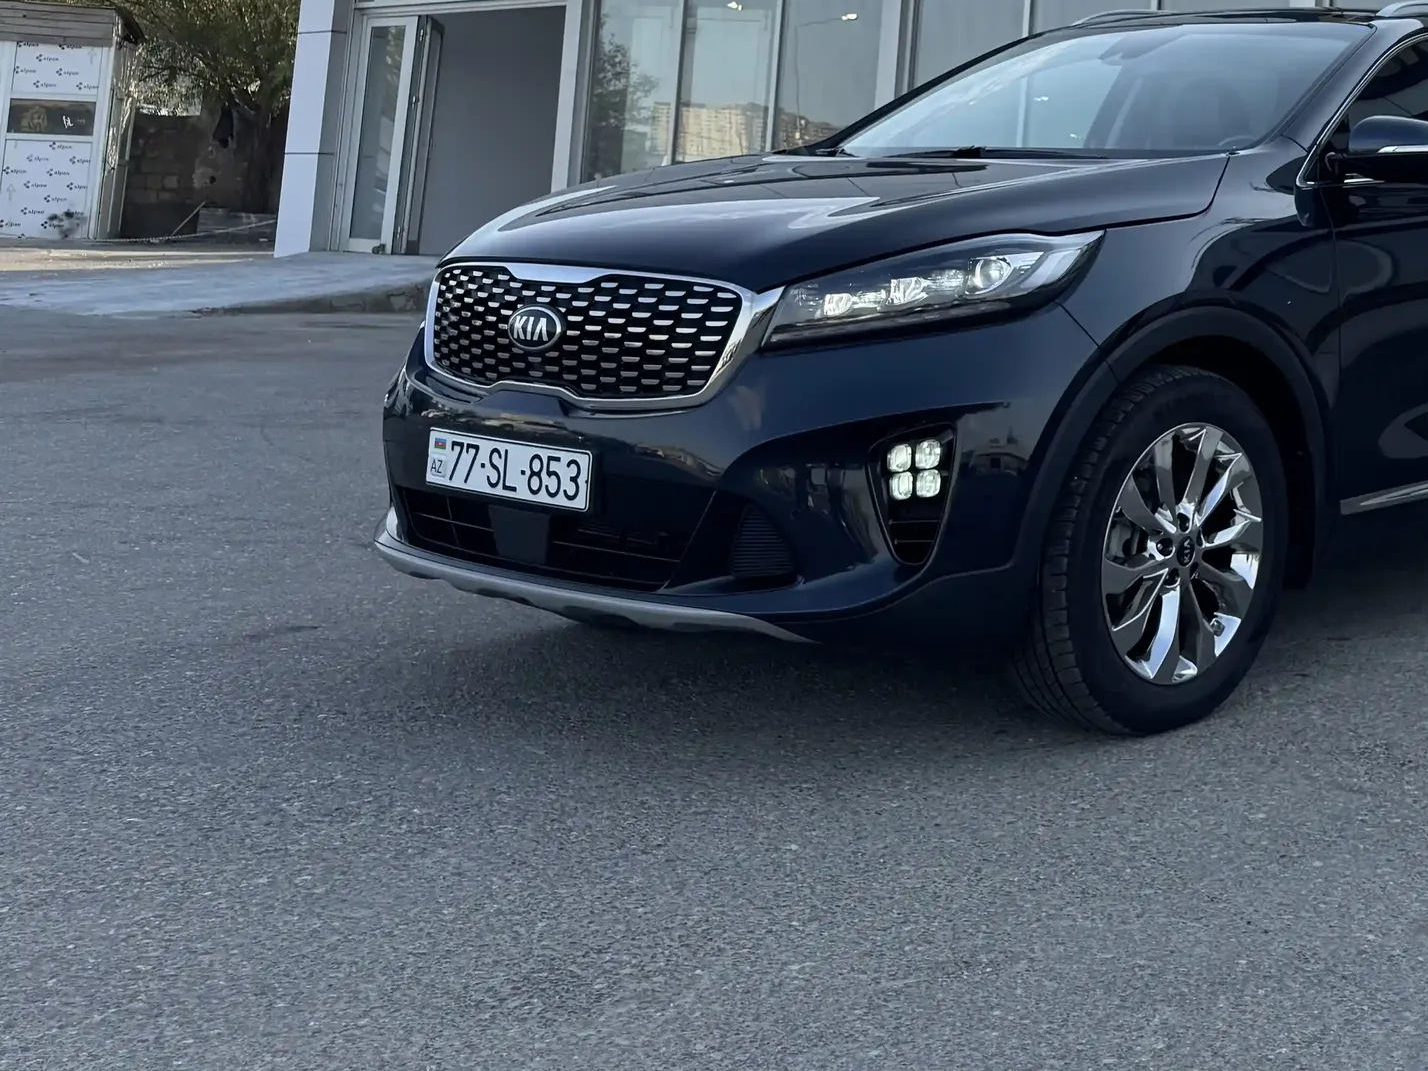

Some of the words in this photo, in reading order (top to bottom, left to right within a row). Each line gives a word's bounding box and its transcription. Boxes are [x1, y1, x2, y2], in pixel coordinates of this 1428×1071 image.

[513, 316, 549, 341] KIA
[430, 457, 443, 474] AZ
[449, 441, 582, 501] 77-SL-853
